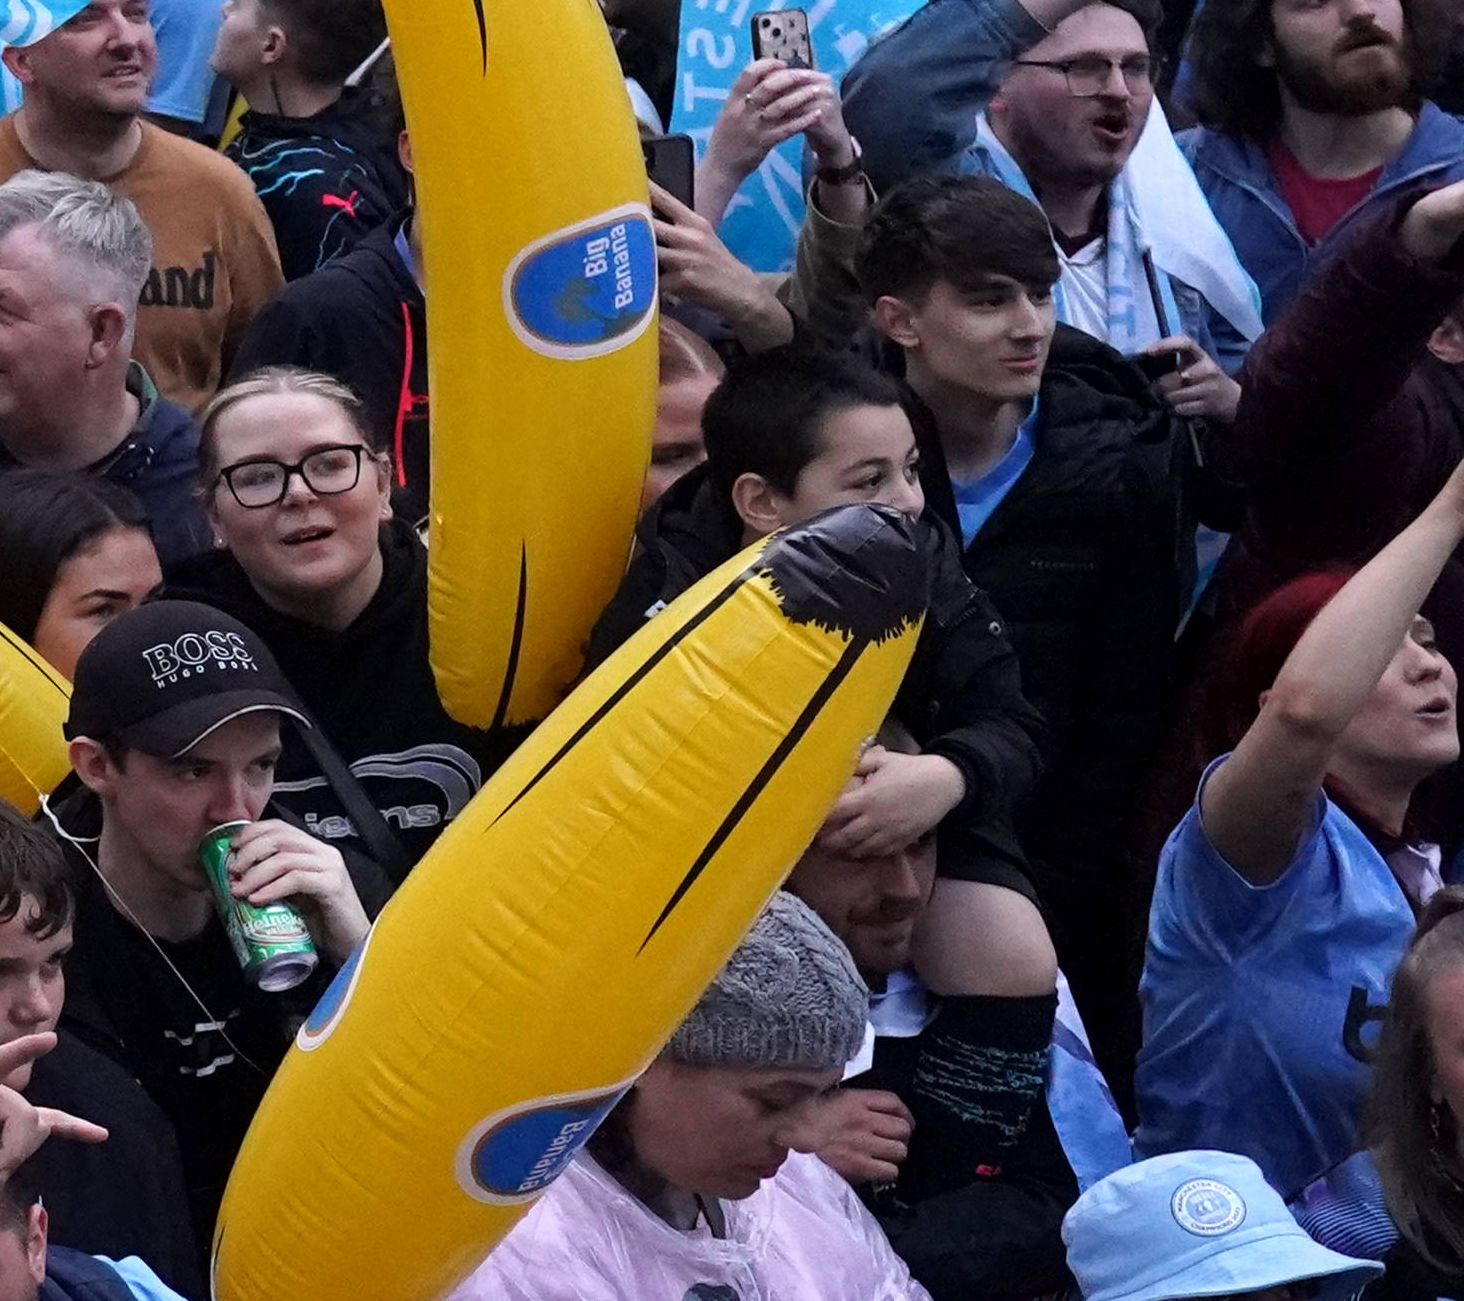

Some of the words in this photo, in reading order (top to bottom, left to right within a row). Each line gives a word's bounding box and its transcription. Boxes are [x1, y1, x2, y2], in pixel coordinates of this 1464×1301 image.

[138, 250, 215, 310] and
[583, 236, 610, 278] Big
[610, 223, 634, 310] Banana
[141, 629, 255, 681] BOSS
[156, 663, 205, 690] HUGO
[304, 804, 442, 839] jens
[516, 1117, 591, 1192] Banana
